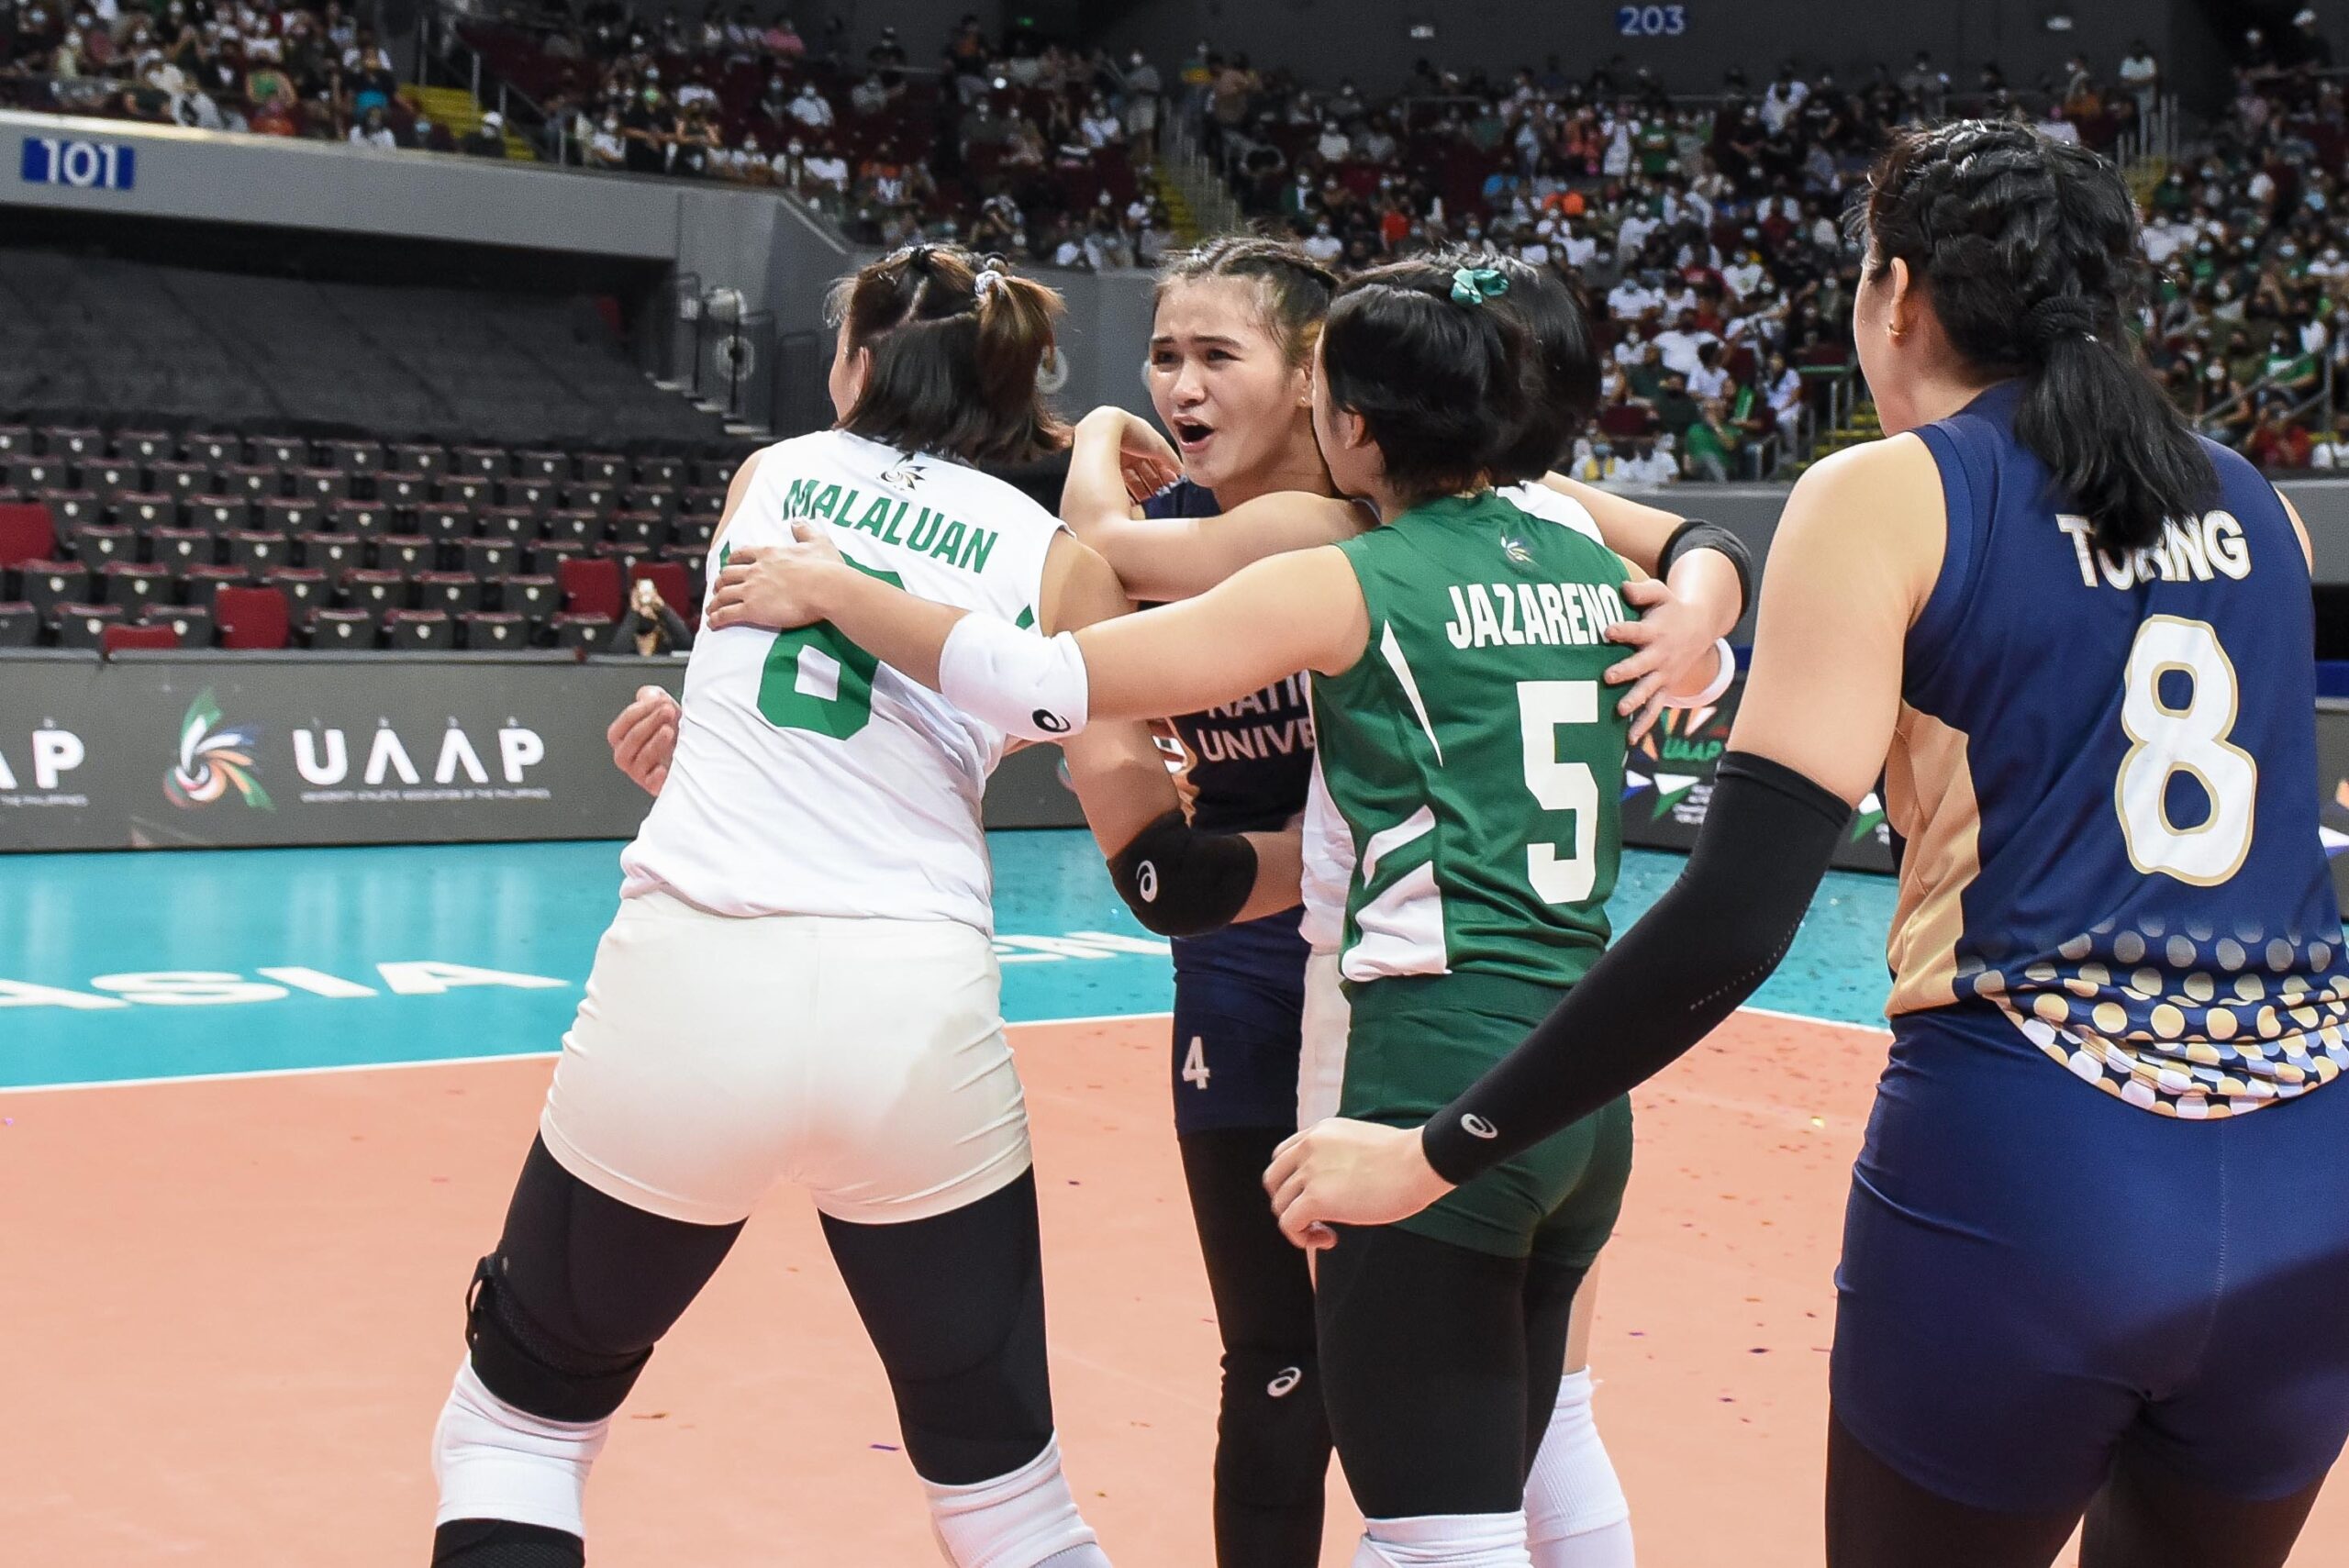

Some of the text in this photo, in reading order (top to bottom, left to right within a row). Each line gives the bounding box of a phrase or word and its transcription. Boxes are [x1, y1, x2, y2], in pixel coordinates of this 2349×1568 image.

[1620, 5, 1685, 36] 203
[40, 139, 117, 188] 101
[782, 479, 999, 574] MALALUAN
[1445, 583, 1626, 650] JAZARENO
[293, 728, 545, 785] UAAP
[2114, 614, 2257, 887] 8
[1516, 680, 1599, 905] 5
[0, 961, 571, 1009] ASIA
[1182, 1036, 1210, 1090] 4
